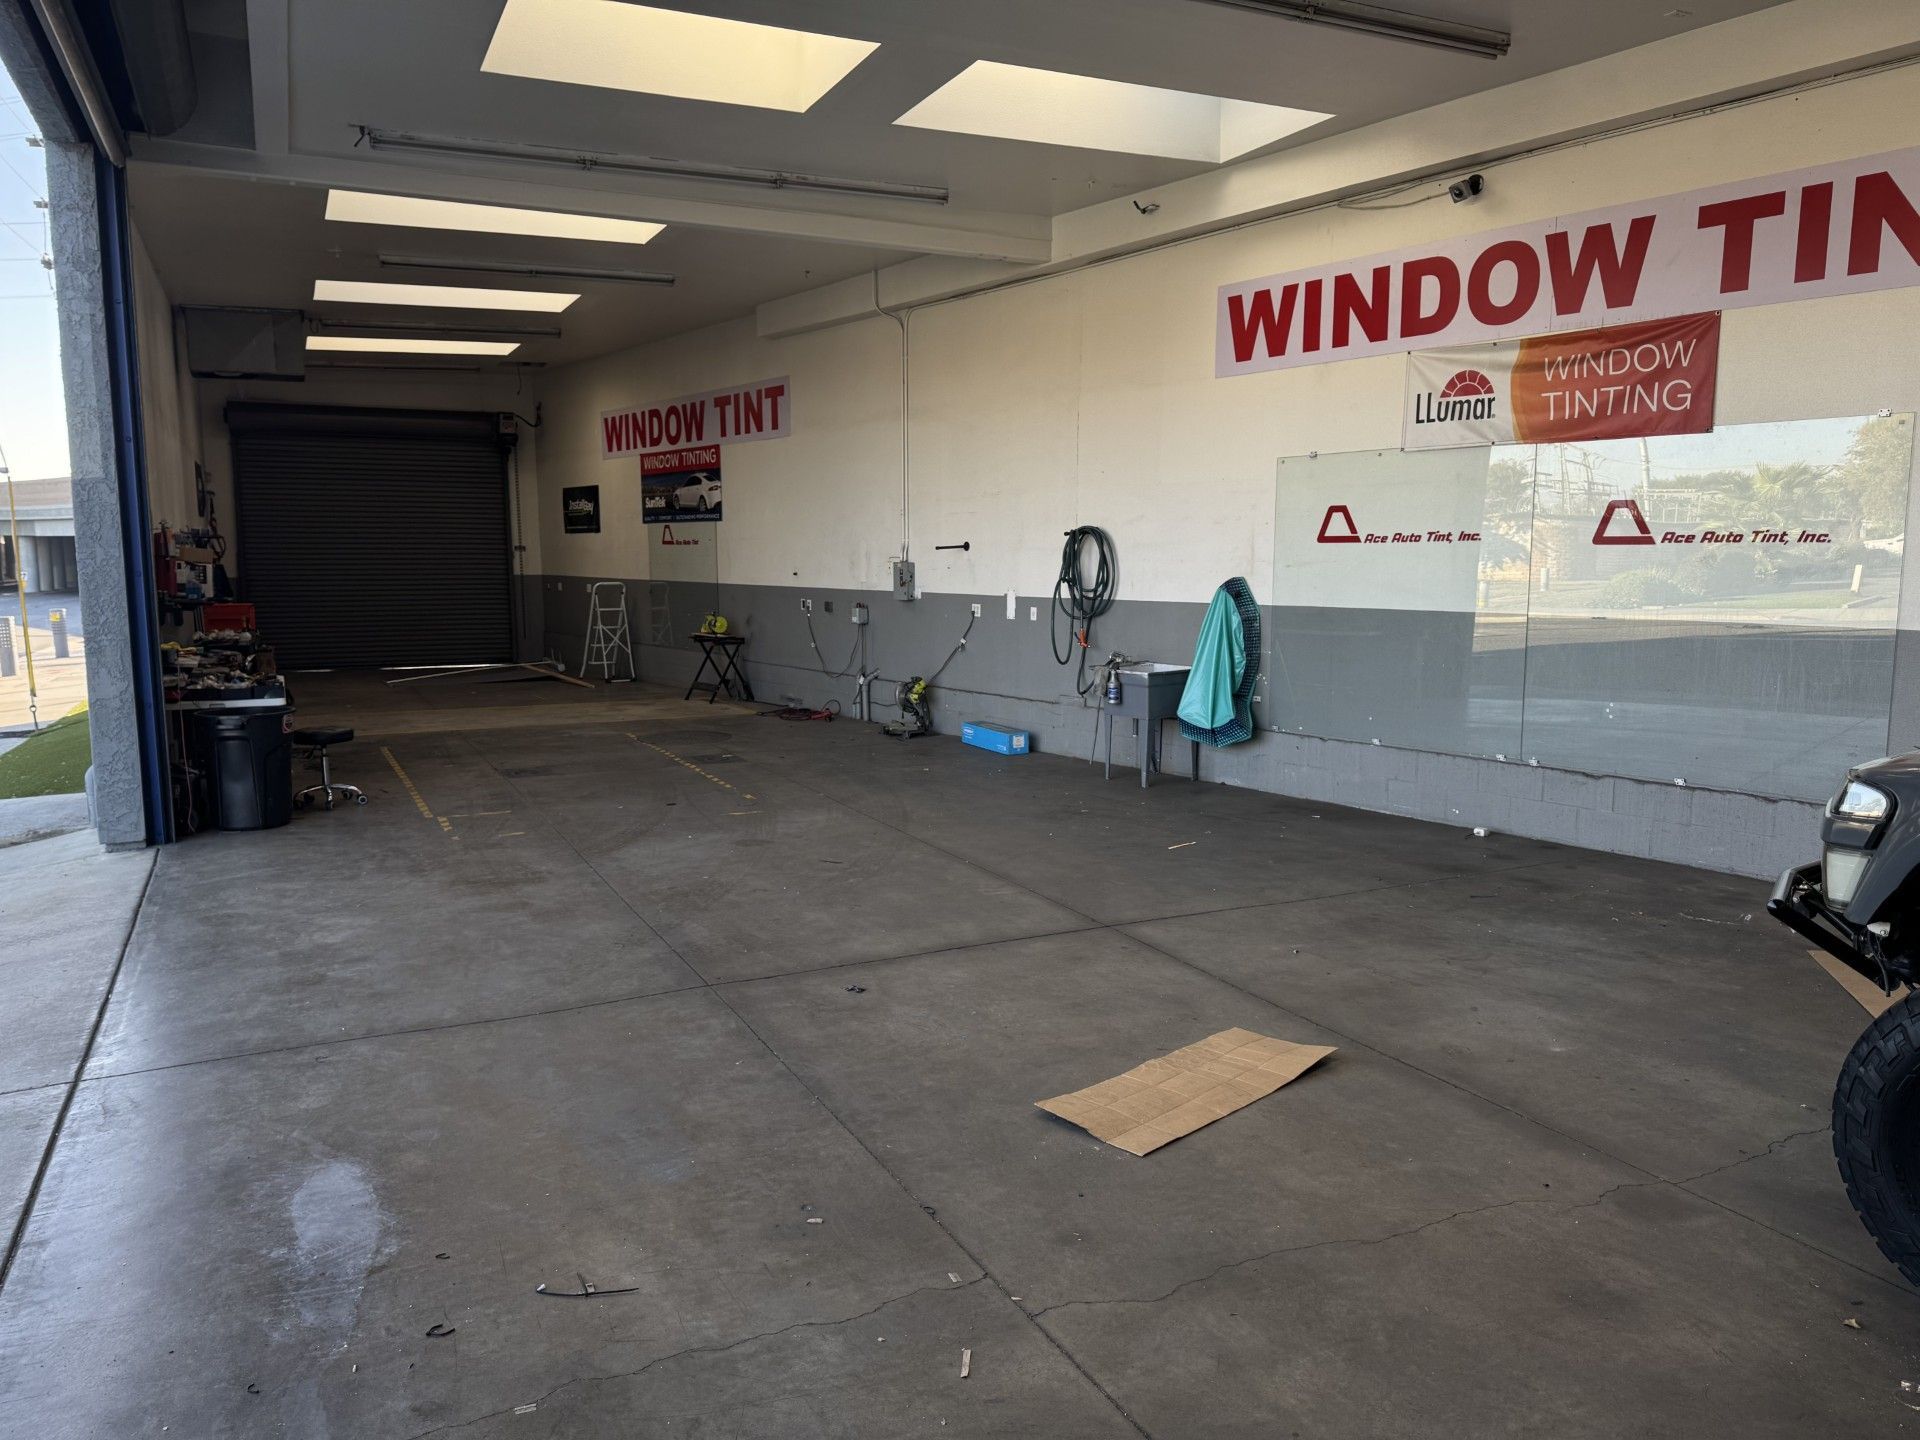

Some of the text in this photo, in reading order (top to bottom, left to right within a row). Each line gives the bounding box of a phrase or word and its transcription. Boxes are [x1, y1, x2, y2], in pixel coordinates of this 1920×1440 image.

[1228, 171, 1920, 363] WINDOW TIN
[1544, 339, 1696, 381] WINDOW
[1416, 391, 1496, 424] LLumar
[1541, 379, 1692, 421] TINTING
[604, 385, 785, 452] WINDOW TINT
[643, 448, 717, 470] WINDOW TINTING
[645, 496, 666, 508] SunTek
[1364, 530, 1482, 544] Ace Auto Tint, Inc.
[1660, 530, 1832, 546] Ace Auto Tint, Inc.
